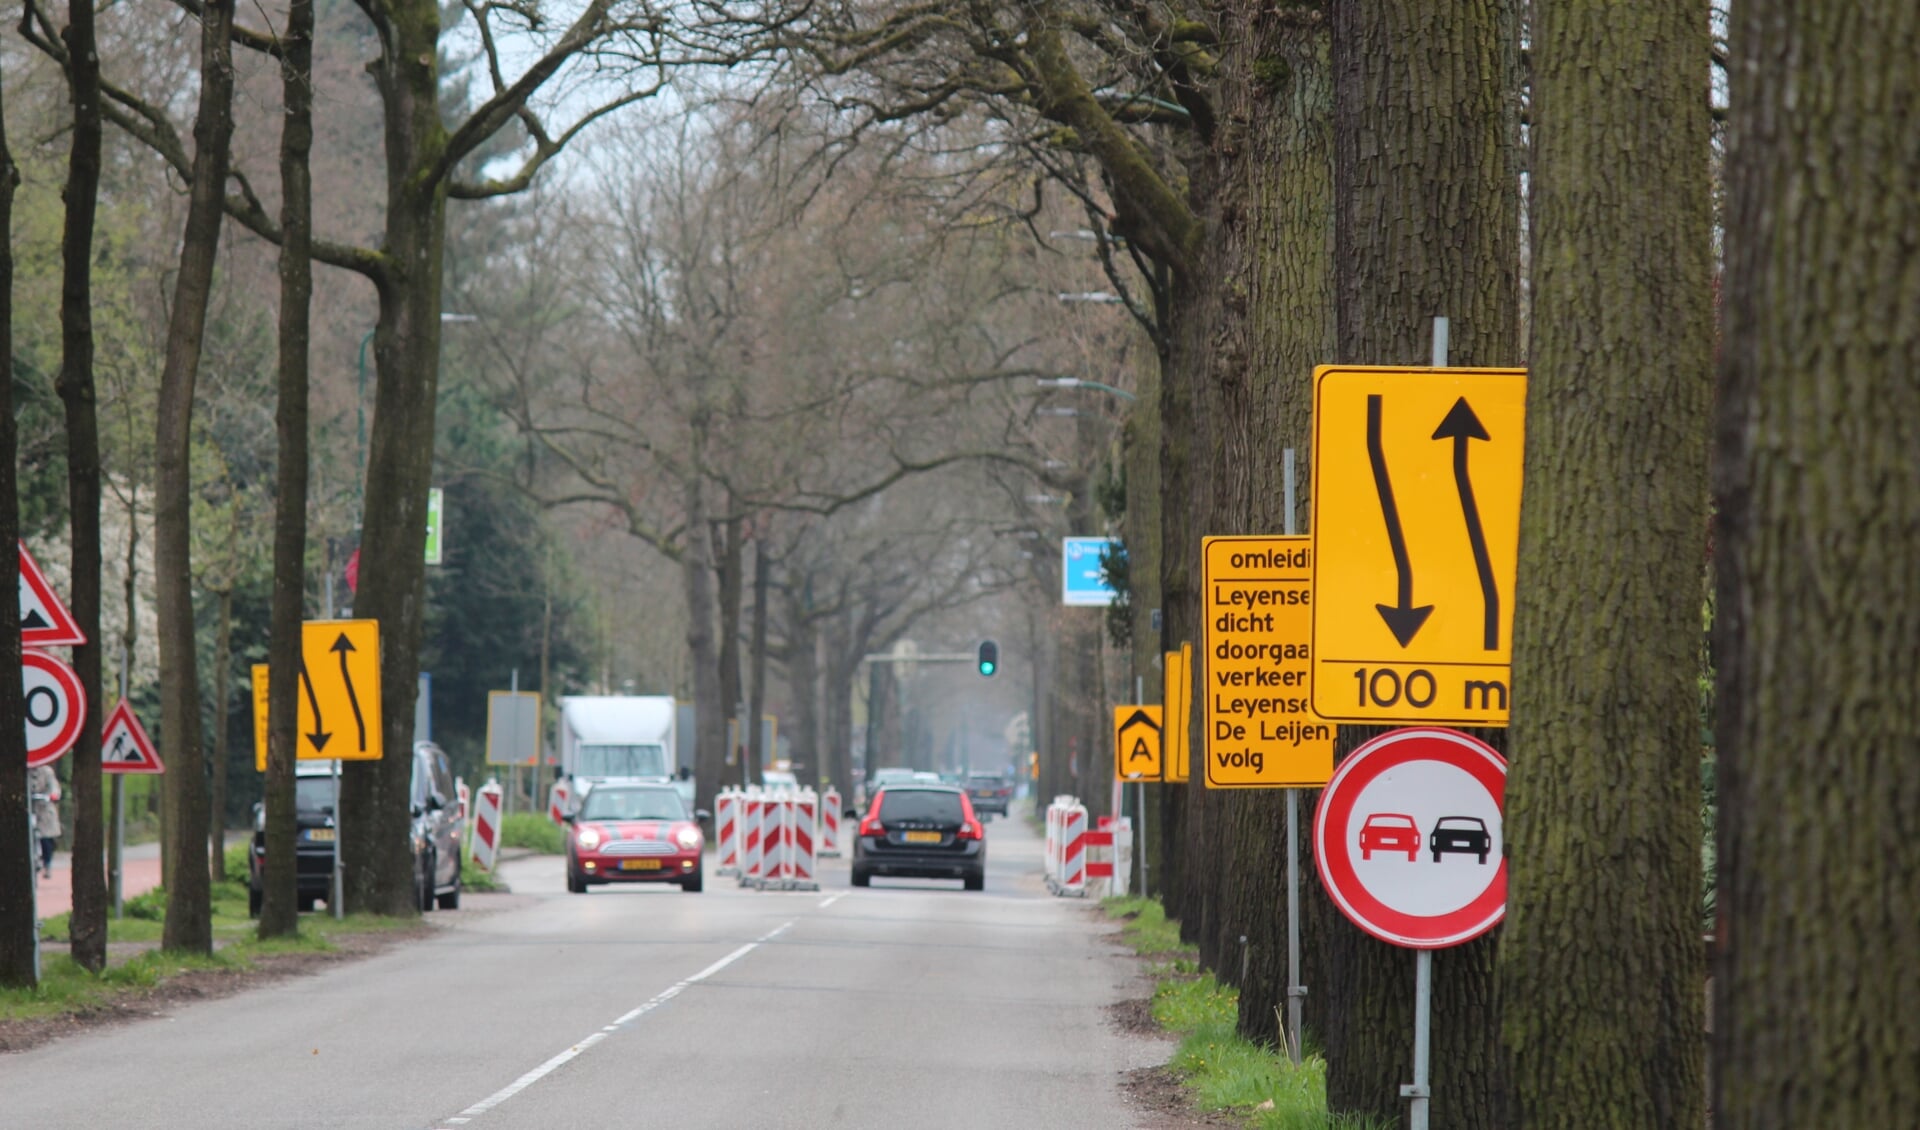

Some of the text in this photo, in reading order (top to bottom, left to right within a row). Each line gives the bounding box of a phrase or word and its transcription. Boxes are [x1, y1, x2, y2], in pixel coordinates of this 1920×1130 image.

[1215, 585, 1310, 610] Leyense
[1216, 612, 1274, 632] dicht
[1216, 639, 1309, 665] doorgaa
[1217, 666, 1307, 686] verkeer
[1354, 668, 1508, 710] 100 m
[1216, 720, 1330, 747] De Leijen
[1129, 736, 1153, 762] A
[1217, 747, 1264, 774] volg
